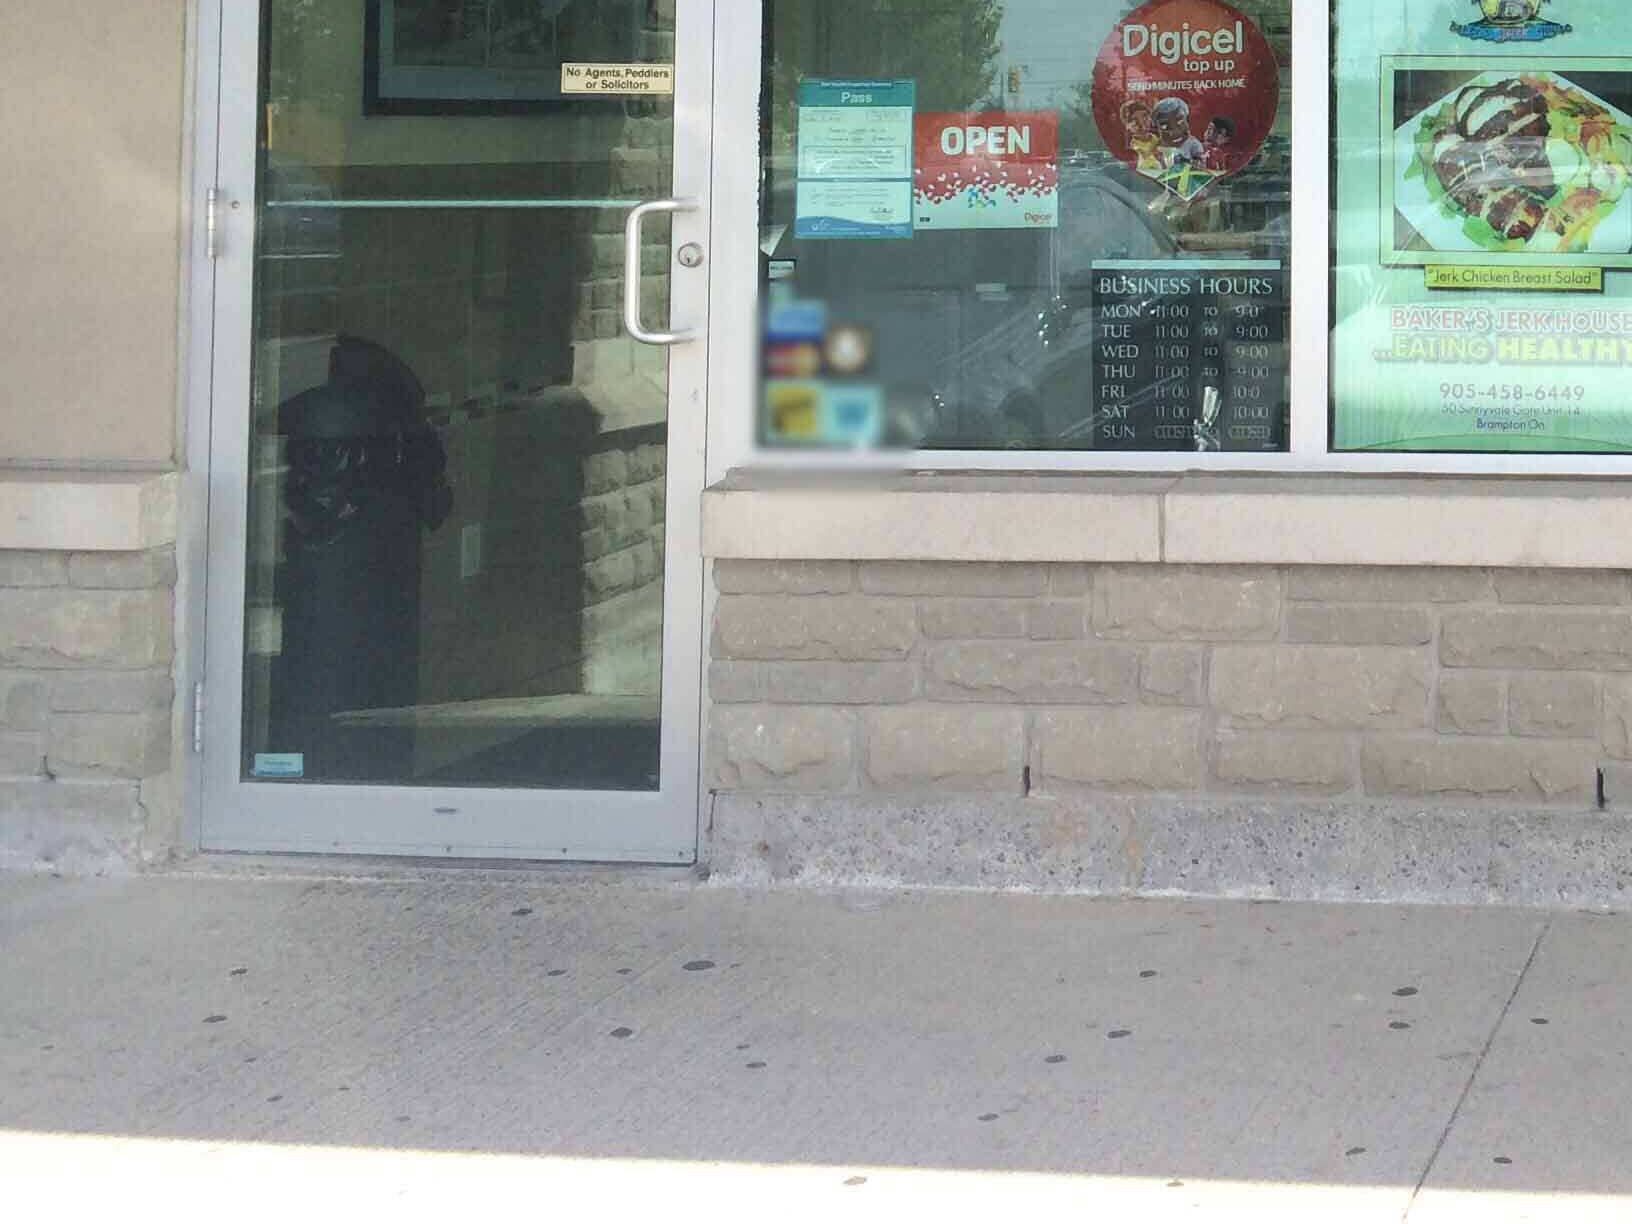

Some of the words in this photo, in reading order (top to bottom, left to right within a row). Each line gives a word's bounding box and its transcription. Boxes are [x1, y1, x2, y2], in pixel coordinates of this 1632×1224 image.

[1122, 20, 1243, 64] Digicel
[566, 67, 581, 77] No
[585, 67, 624, 79] Agents,
[625, 68, 669, 78] Peddlers
[1183, 59, 1209, 74] top
[1214, 59, 1235, 74] up
[585, 80, 597, 89] or
[600, 79, 650, 89] Solicitors
[1151, 79, 1192, 90] MINUTES
[1193, 78, 1217, 89] BACK
[1218, 77, 1246, 88] HOME
[840, 91, 873, 104] Pass
[940, 125, 1031, 155] OPEN
[1427, 269, 1458, 283] "Jerk
[1462, 269, 1510, 283] Chicken
[1512, 270, 1552, 284] Breast
[1554, 271, 1599, 284] Salad"
[1100, 277, 1191, 295] BUSINESS
[1200, 278, 1273, 295] HOURS
[1100, 305, 1141, 318] MON
[1203, 306, 1218, 316] TO
[1391, 308, 1492, 331] BAKER'S
[1495, 309, 1547, 332] JERK
[1102, 324, 1132, 338] TUE
[1204, 326, 1218, 337] TO
[1235, 325, 1268, 338] 9:00
[1101, 344, 1139, 358] WED
[1204, 346, 1218, 356] TO
[1235, 345, 1268, 358] 9:00
[1101, 364, 1136, 378] THU
[1101, 384, 1126, 398] FRI
[1439, 383, 1585, 401] 905-458-6449
[1102, 404, 1131, 418] SAT
[1102, 425, 1136, 438] SUN
[1476, 418, 1526, 432] Brampton
[1528, 418, 1545, 430] On
